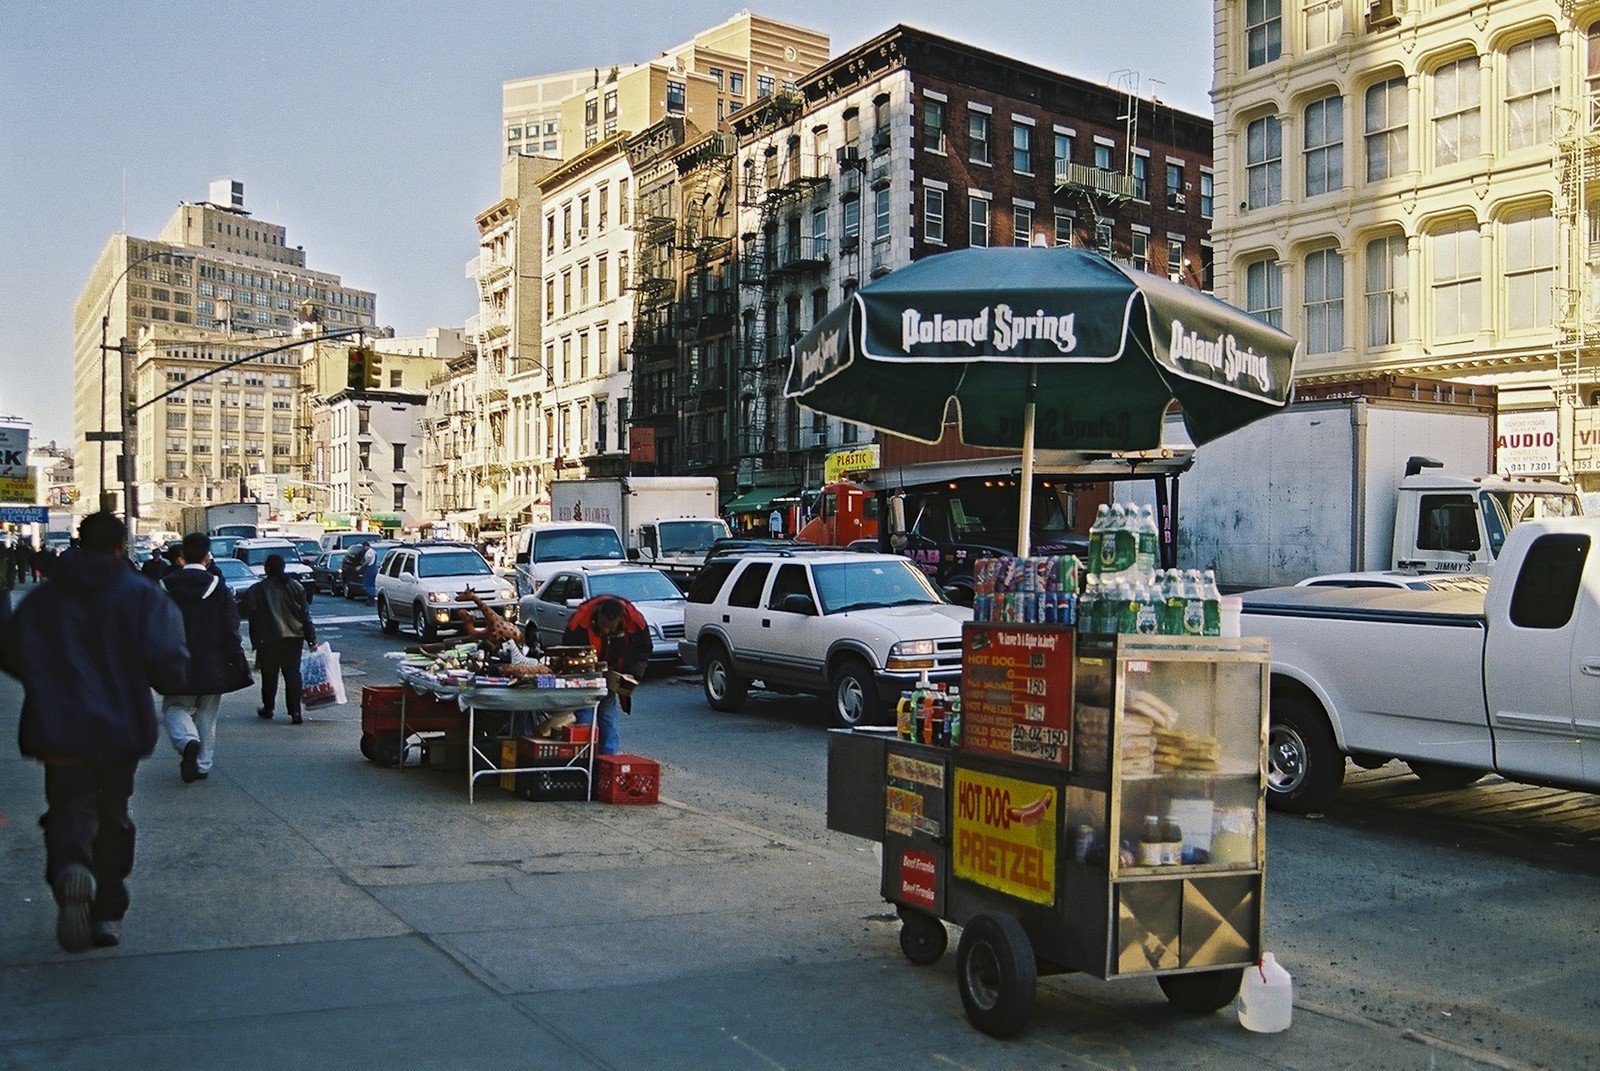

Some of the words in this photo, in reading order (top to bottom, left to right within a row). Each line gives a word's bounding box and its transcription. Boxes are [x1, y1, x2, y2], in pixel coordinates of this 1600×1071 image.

[902, 306, 989, 353] Poland
[993, 304, 1077, 353] Spring
[1170, 319, 1224, 372] Poland
[1224, 334, 1270, 392] Spring
[1496, 432, 1554, 448] AUDIO
[1579, 430, 1600, 446] VI
[836, 453, 867, 466] PLASTIC
[1530, 462, 1551, 471] 7301
[1434, 562, 1471, 571] JIMMY'S
[967, 655, 989, 665] HOT
[992, 656, 1015, 667] DOG
[958, 780, 982, 822] HOT
[985, 786, 1011, 830] DOG
[959, 827, 1051, 892] PRETZEL
